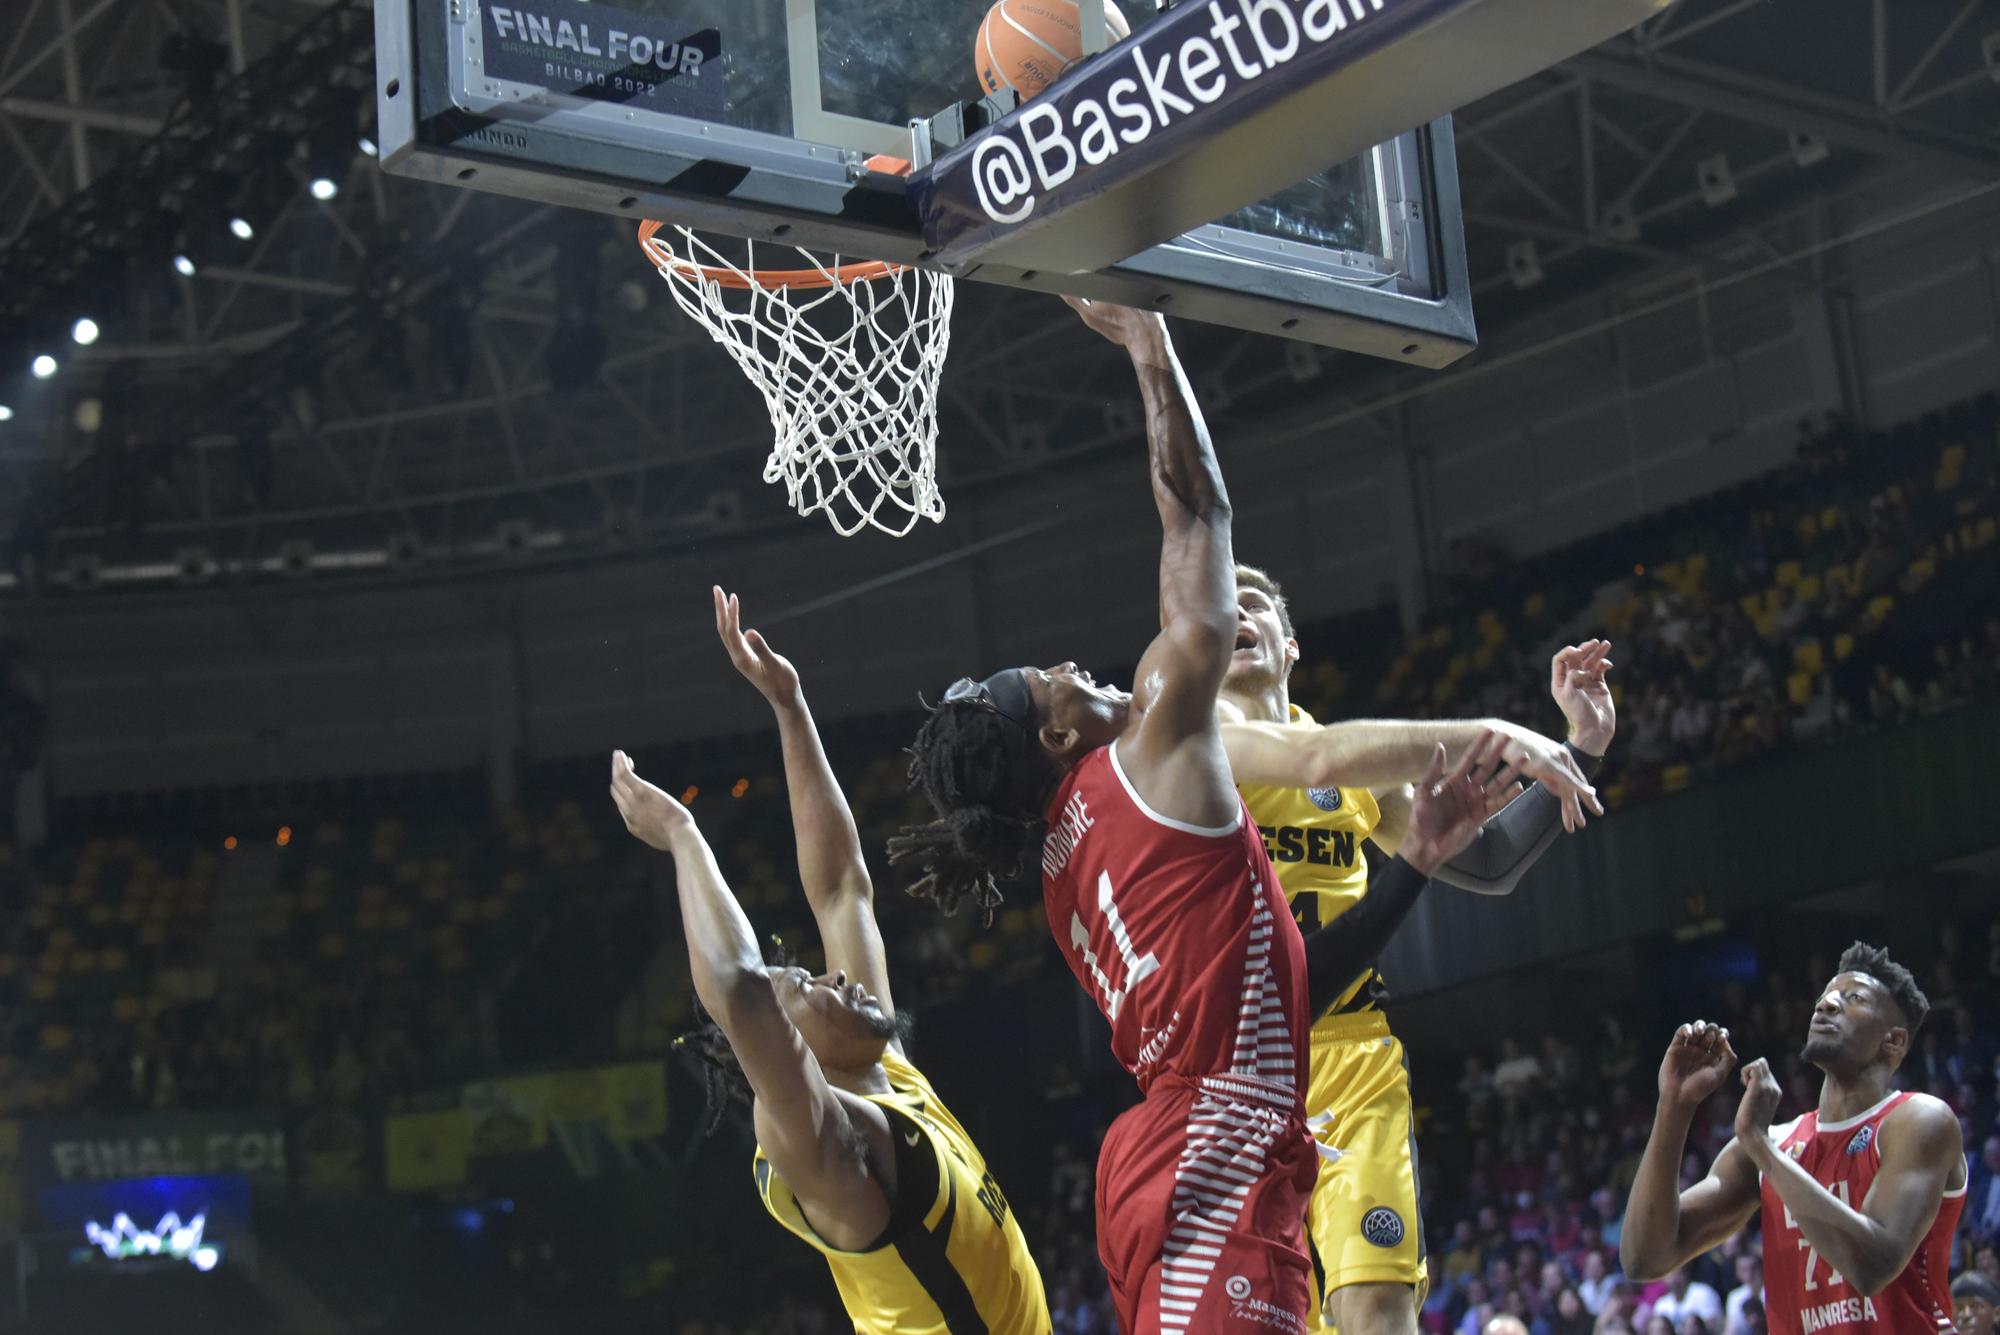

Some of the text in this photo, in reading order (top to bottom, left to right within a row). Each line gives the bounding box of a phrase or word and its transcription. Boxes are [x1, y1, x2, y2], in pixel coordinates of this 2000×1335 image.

[490, 6, 704, 76] FINAL FOUR
[545, 63, 655, 97] BILBAO 2022
[971, 0, 1384, 224] @Basketba
[1259, 825, 1354, 868] ESEN
[1071, 869, 1160, 1022] 11
[51, 1137, 195, 1182] FINAL
[1248, 1298, 1297, 1323] Manresa
[1801, 1296, 1878, 1335] MANRESA
